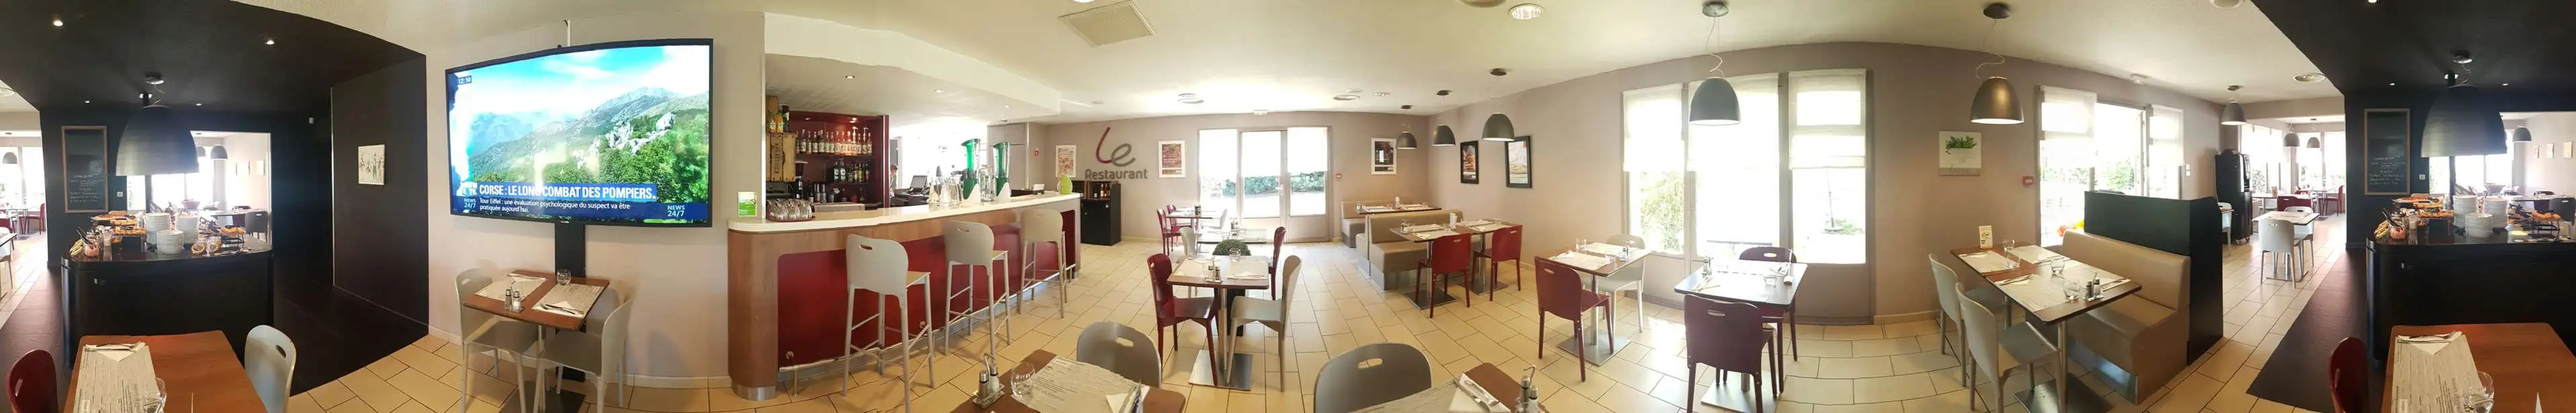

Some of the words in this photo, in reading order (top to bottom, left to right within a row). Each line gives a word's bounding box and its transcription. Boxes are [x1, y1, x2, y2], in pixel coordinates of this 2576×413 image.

[1096, 127, 1136, 167] Le
[1085, 169, 1148, 179] Restaurant
[480, 185, 504, 195] CORSE
[508, 185, 517, 195] LE
[543, 186, 581, 197] COMBAT
[583, 187, 600, 198] DES
[540, 201, 578, 209] psychologique
